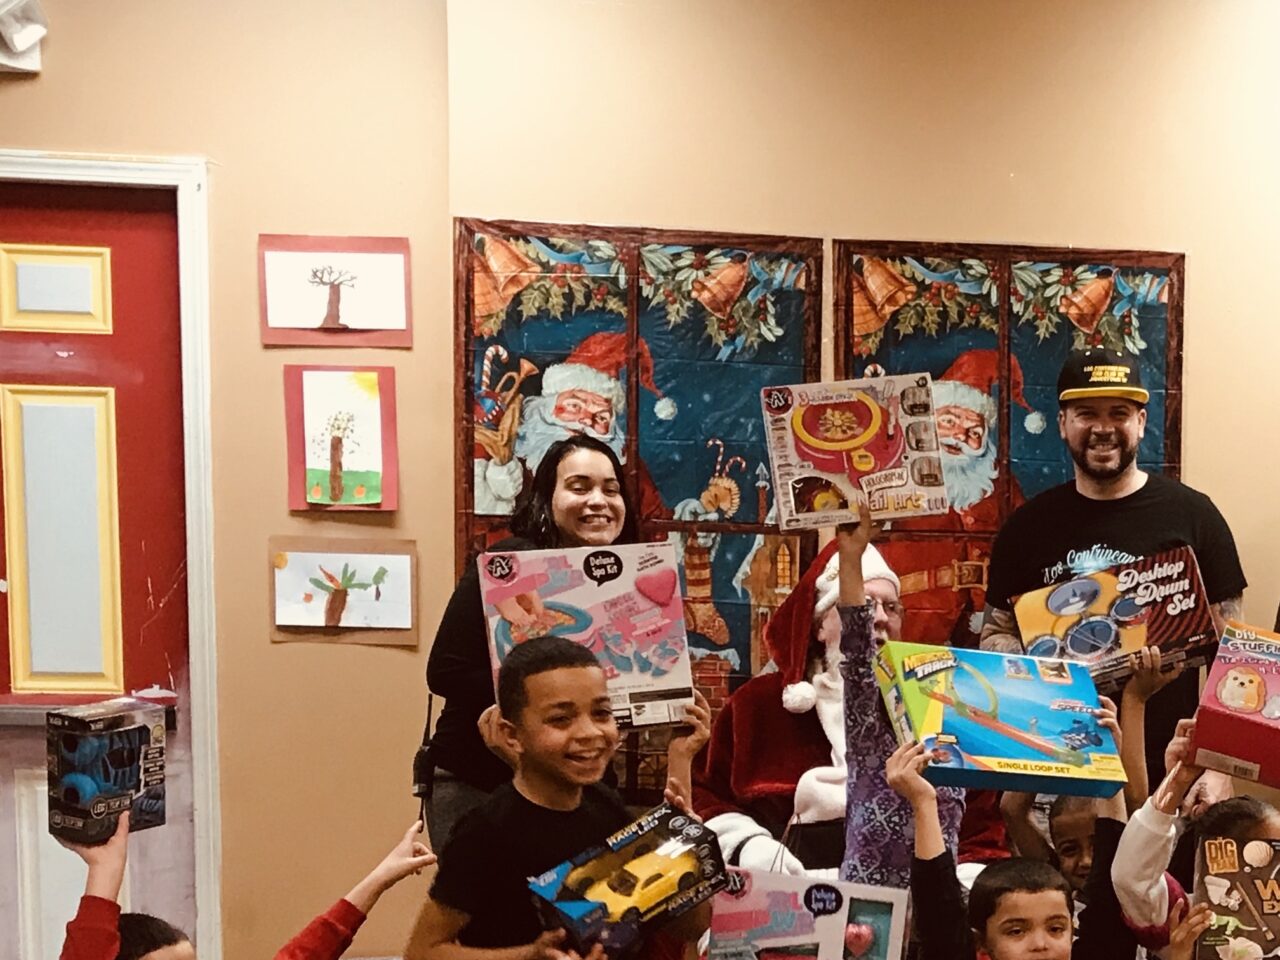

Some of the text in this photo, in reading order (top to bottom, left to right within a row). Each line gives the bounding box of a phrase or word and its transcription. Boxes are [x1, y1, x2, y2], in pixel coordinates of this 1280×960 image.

[592, 565, 618, 578] Spa Kit
[1116, 560, 1185, 592] Desktop
[1135, 578, 1190, 606] Drum
[1166, 593, 1196, 616] Set
[997, 761, 1070, 774] SINGLE LOOP SET
[1206, 840, 1236, 860] DIG
